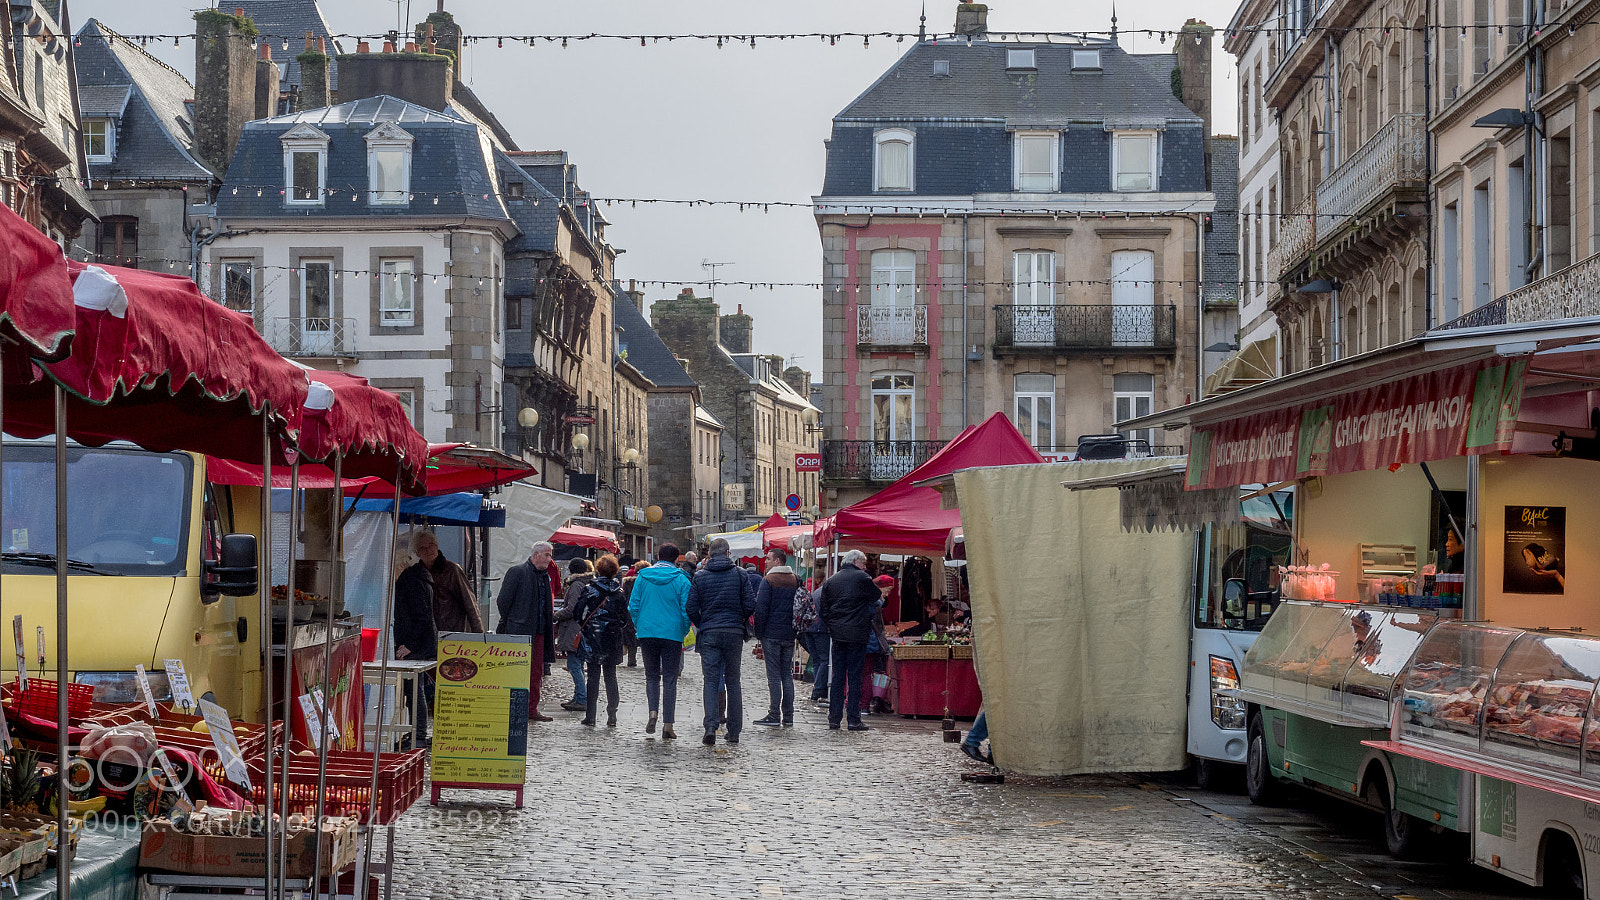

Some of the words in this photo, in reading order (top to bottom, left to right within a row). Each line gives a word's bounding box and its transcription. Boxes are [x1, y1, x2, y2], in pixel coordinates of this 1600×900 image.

[796, 457, 820, 466] ORPI
[442, 643, 479, 656] Chez
[479, 645, 528, 659] Mouss
[464, 681, 501, 690] Couscous
[434, 742, 467, 753] Tagine
[480, 745, 498, 755] jour
[1583, 800, 1600, 822] Kerh
